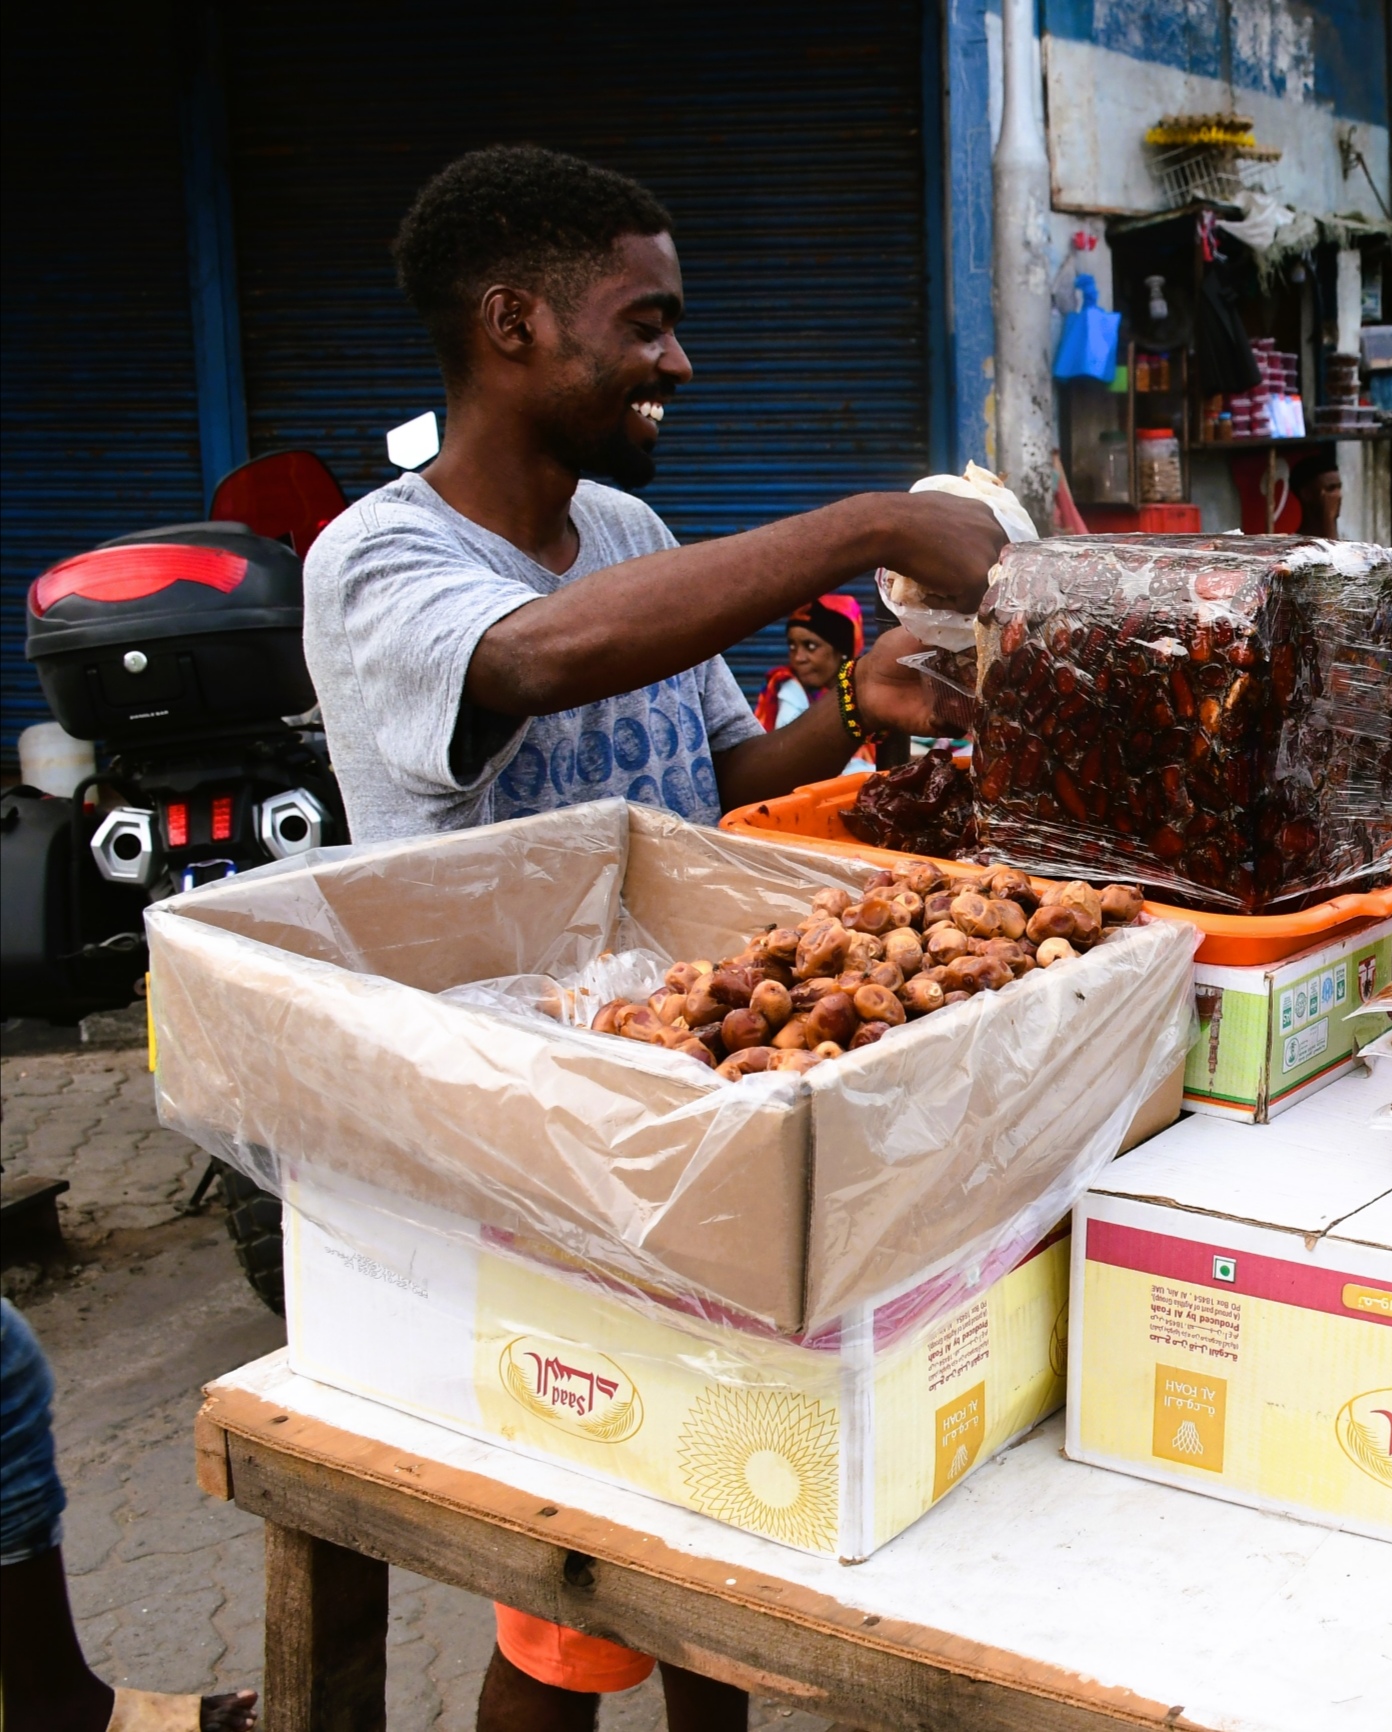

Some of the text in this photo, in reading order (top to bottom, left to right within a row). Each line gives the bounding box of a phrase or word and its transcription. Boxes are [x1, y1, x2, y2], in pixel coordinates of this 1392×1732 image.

[1151, 1285, 1165, 1295] UAE
[1201, 1306, 1214, 1314] part
[1214, 1309, 1232, 1318] proud
[1217, 1300, 1229, 1309] Box
[1231, 1303, 1241, 1312] PO
[1150, 1303, 1240, 1332] Produced by Al Foah
[928, 1319, 988, 1362] Produced by Al Foah
[1172, 1339, 1188, 1348] من
[1188, 1342, 1208, 1354] قبل
[1209, 1348, 1238, 1362] الفوعة
[551, 1386, 586, 1416] Saad
[1165, 1380, 1216, 1402] AL FOAH
[943, 1399, 978, 1431] AL FOAH
